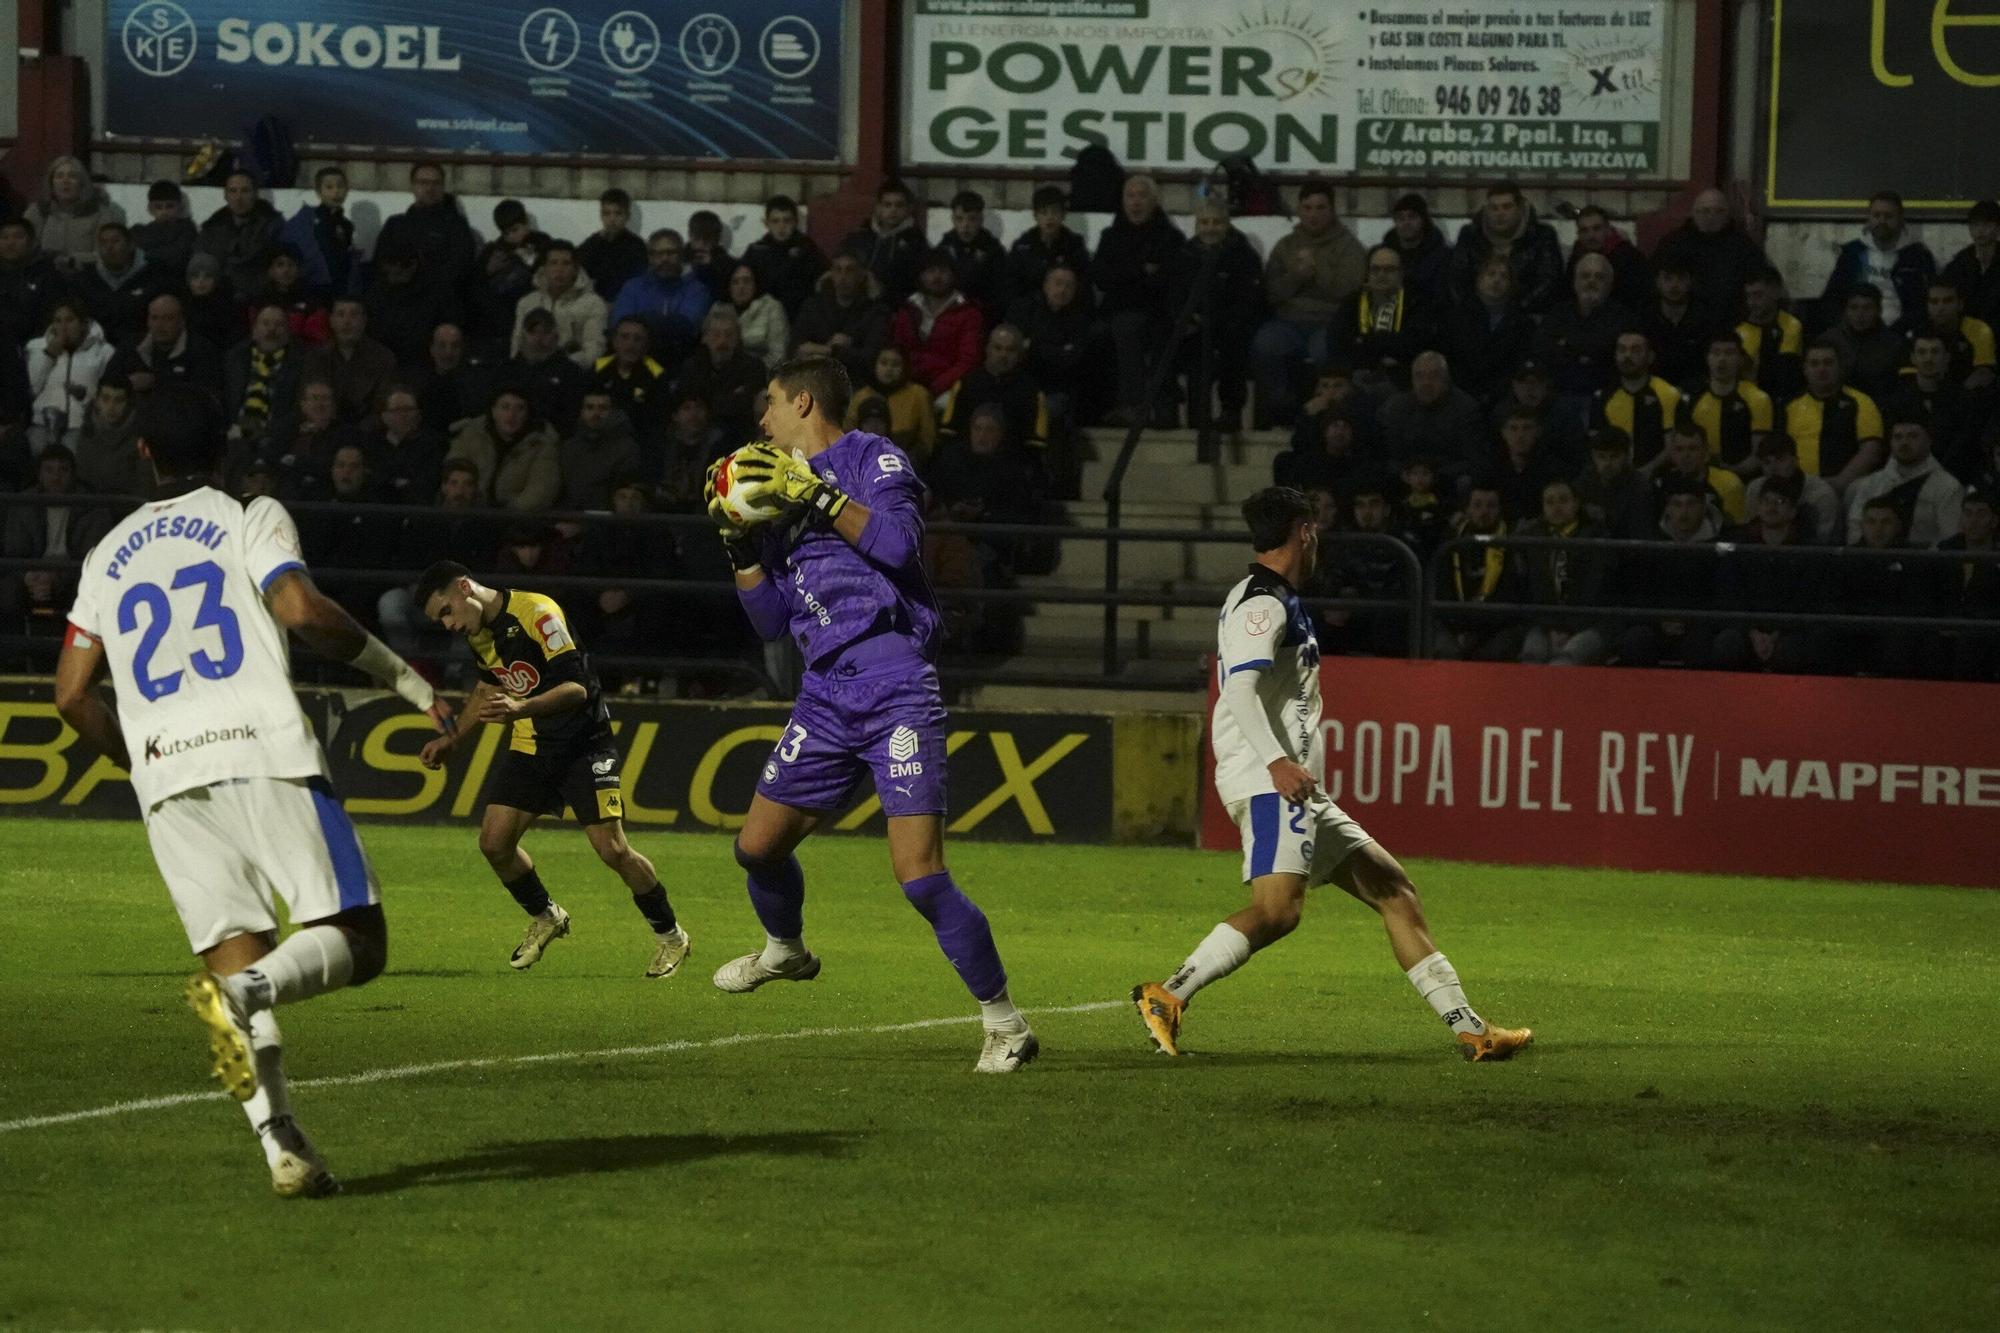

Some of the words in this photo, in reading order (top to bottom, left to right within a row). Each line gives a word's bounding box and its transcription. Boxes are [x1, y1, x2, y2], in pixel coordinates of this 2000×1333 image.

[216, 17, 461, 71] SOKOEL
[1380, 31, 1402, 47] GAS
[1406, 31, 1425, 48] SIN
[1428, 31, 1462, 48] COSTE
[1467, 32, 1514, 48] ALGUNO
[1517, 32, 1549, 48] PARA
[929, 41, 1276, 97] POWER
[1368, 55, 1440, 72] Instalamos
[1443, 56, 1486, 72] Placas
[1436, 85, 1471, 115] 946
[1477, 86, 1500, 115] 09
[1508, 86, 1531, 116] 26
[1537, 86, 1561, 116] 38
[929, 106, 1338, 163] GESTION
[118, 560, 244, 702] 23
[145, 724, 258, 765] Kutxabank
[1319, 718, 1455, 807] COPA
[1480, 725, 1572, 812] DEL
[1597, 730, 1694, 817] REY
[1739, 757, 2000, 807] MAPFRE
[889, 761, 923, 778] EMB
